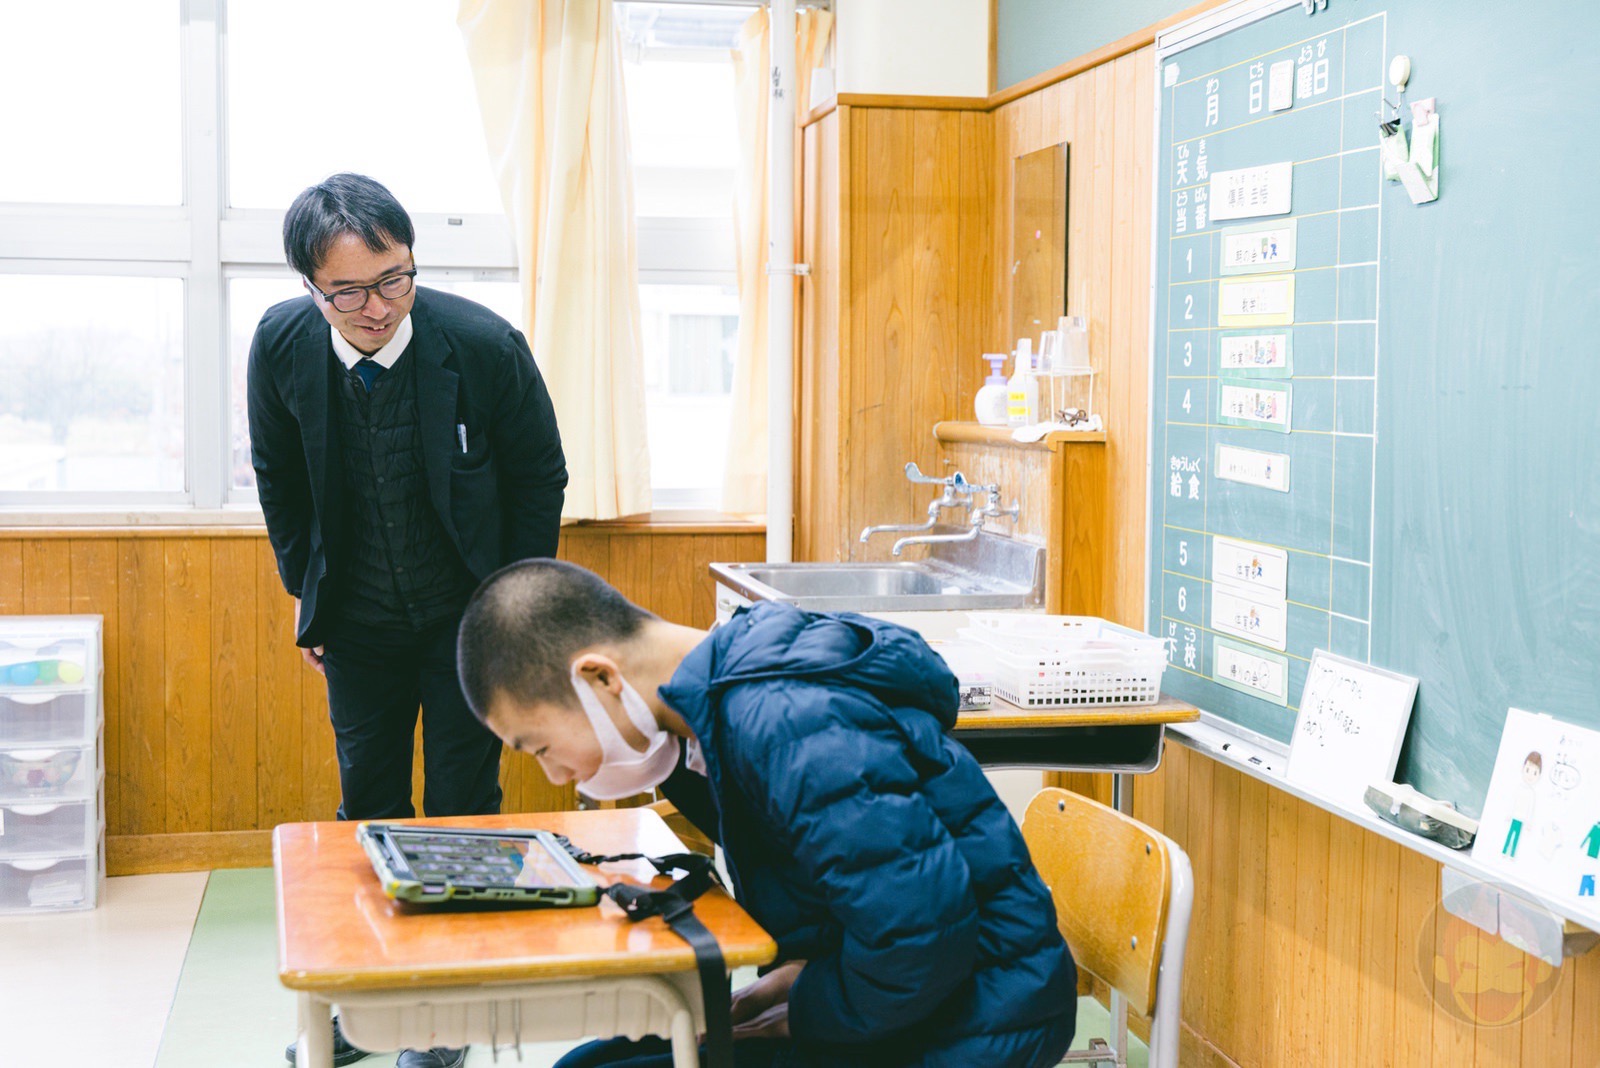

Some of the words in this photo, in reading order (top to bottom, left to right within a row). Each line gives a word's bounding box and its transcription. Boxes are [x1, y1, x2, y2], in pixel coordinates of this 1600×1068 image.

[1249, 61, 1264, 80] にち
[1297, 45, 1313, 65] よう
[1317, 38, 1327, 58] び
[1205, 93, 1219, 127] 月
[1249, 79, 1263, 114] 日
[1296, 58, 1329, 99] 曜日
[1198, 138, 1206, 154] き
[1186, 248, 1193, 274] 1
[1184, 294, 1193, 320] 2
[1183, 341, 1193, 367] 3
[1182, 389, 1191, 414] 4
[1170, 455, 1201, 473] きゅうしょく
[1170, 472, 1200, 501] 給食
[1179, 541, 1188, 566] 5
[1178, 586, 1187, 612] 6
[1167, 637, 1197, 670] 下校
